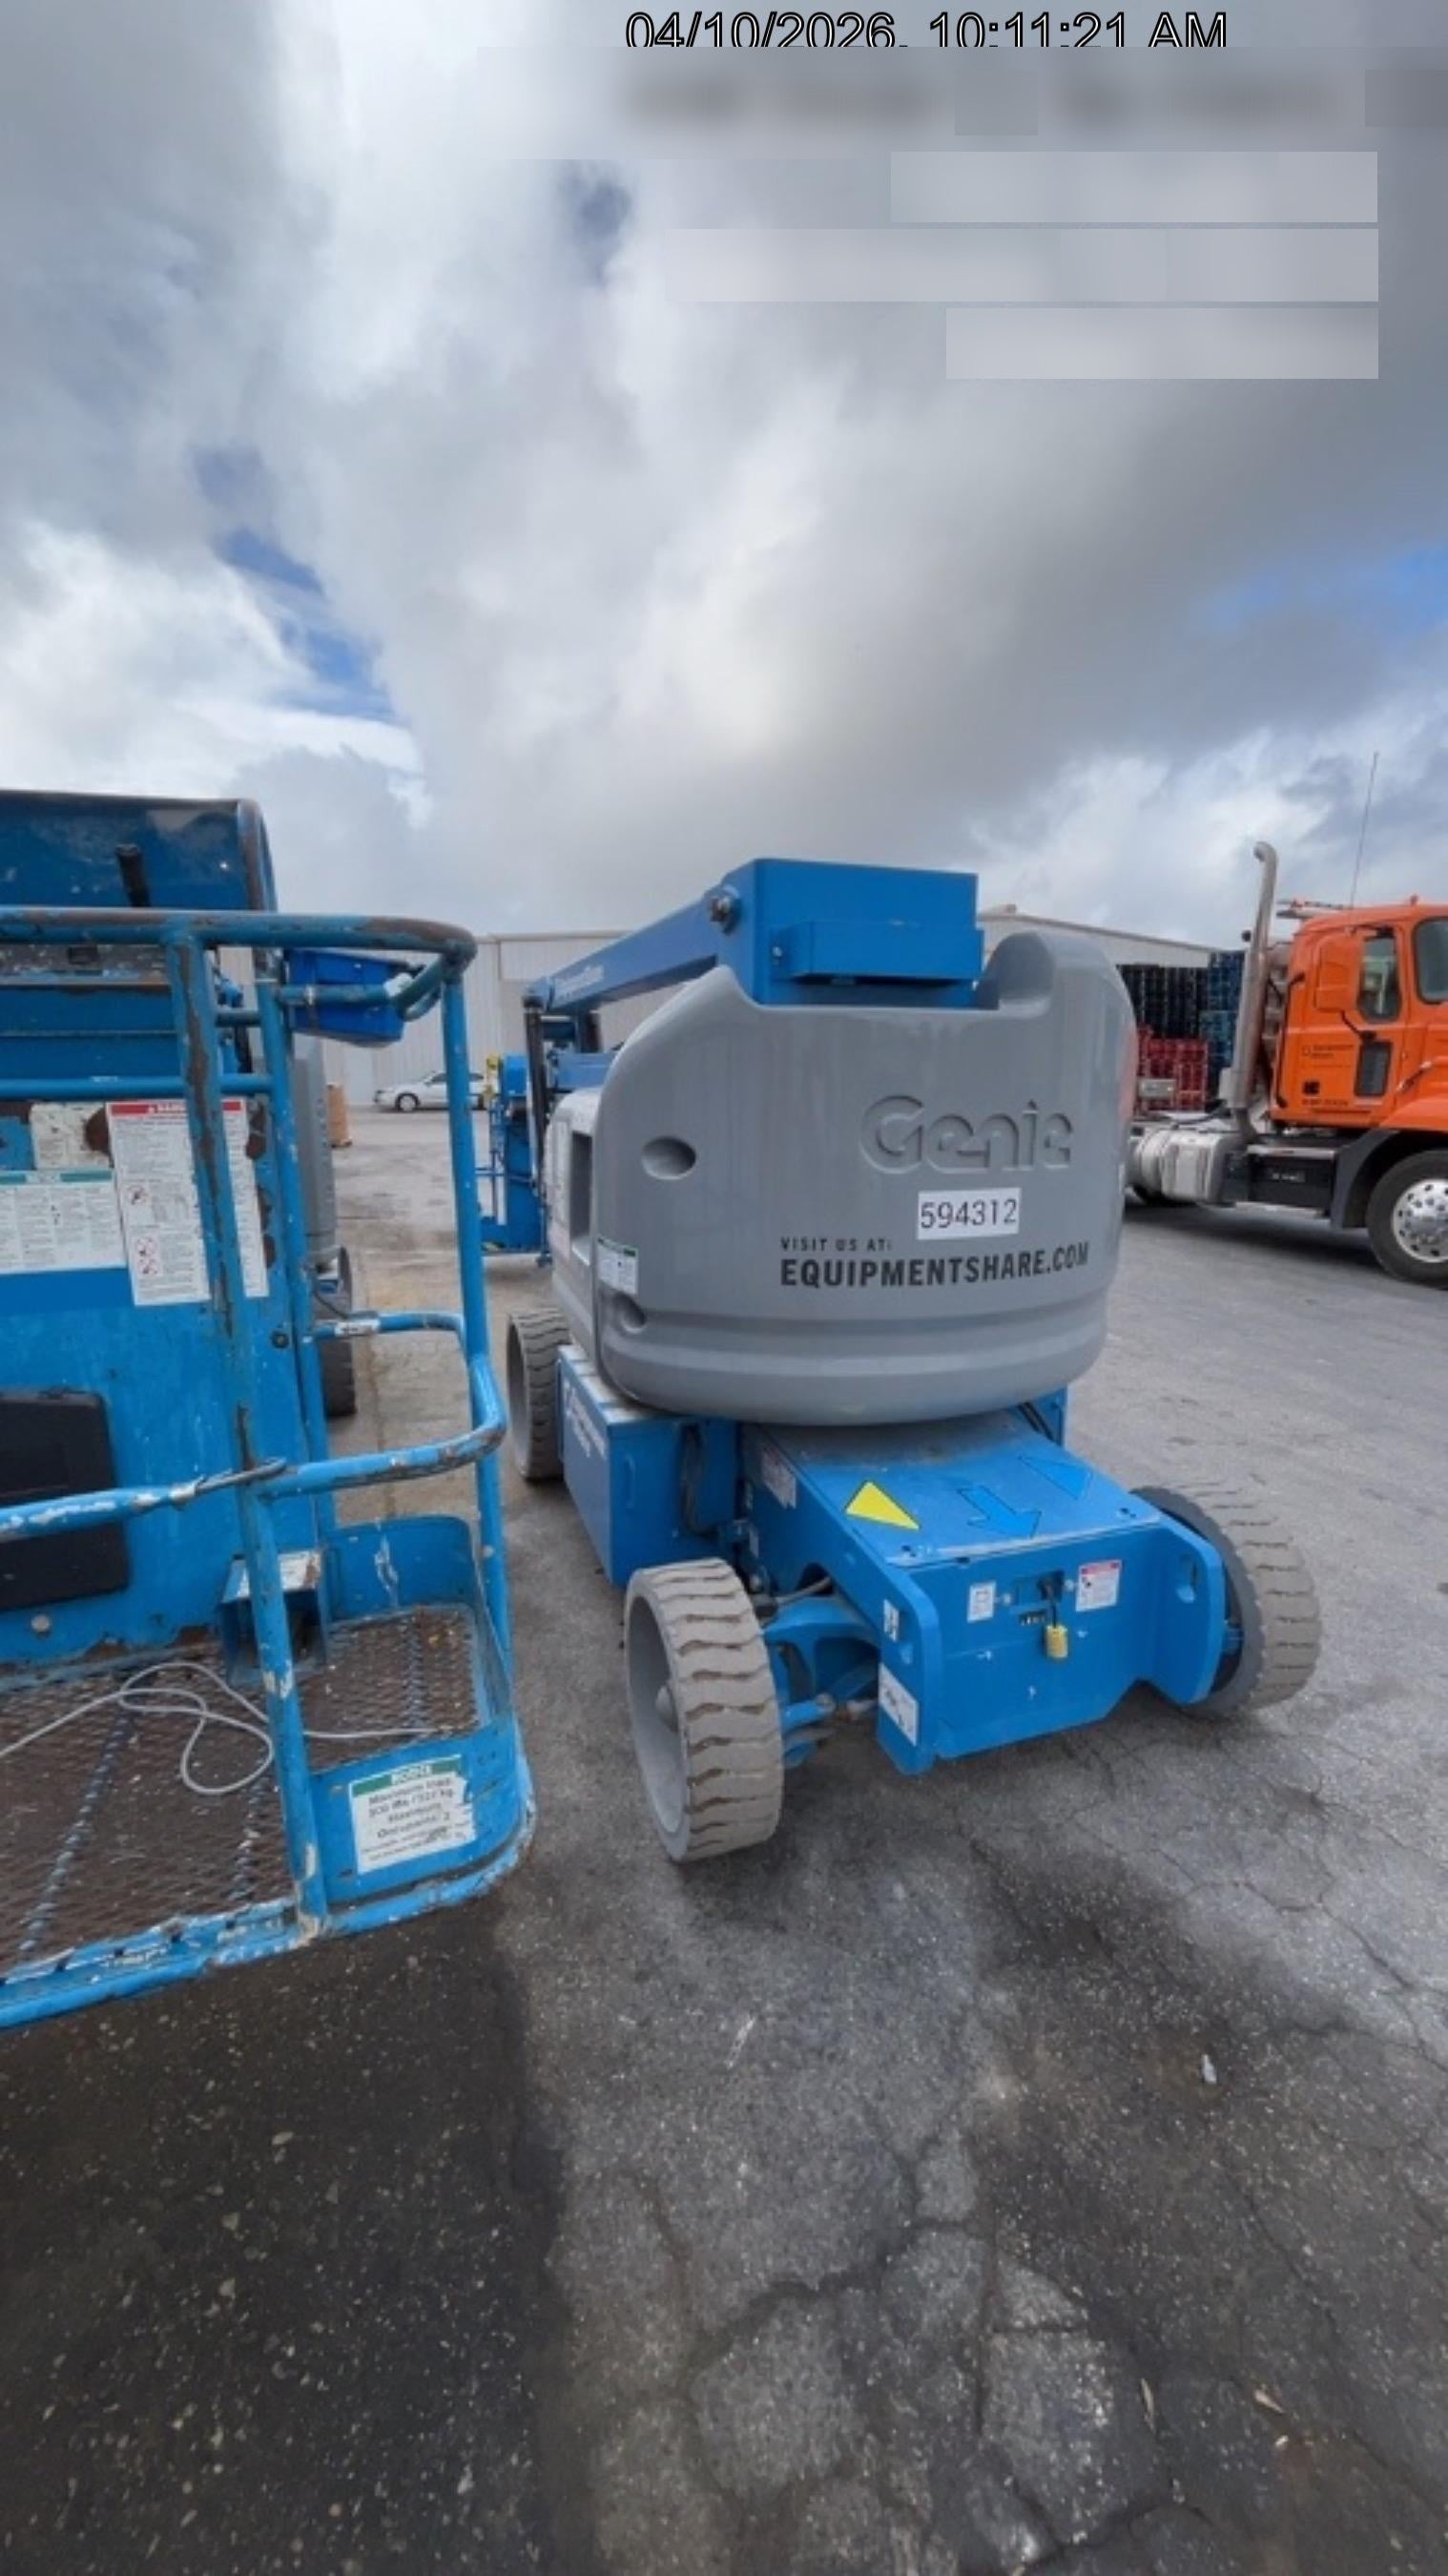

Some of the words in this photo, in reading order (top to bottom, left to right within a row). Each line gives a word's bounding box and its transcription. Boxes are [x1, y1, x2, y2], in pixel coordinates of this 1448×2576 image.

[859, 1094, 1073, 1174] Genie
[921, 1198, 1018, 1229] 594312
[780, 1237, 828, 1252] VISIT
[836, 1238, 858, 1252] US
[780, 1242, 1089, 1288] EQUIPMENTSHARE.COM
